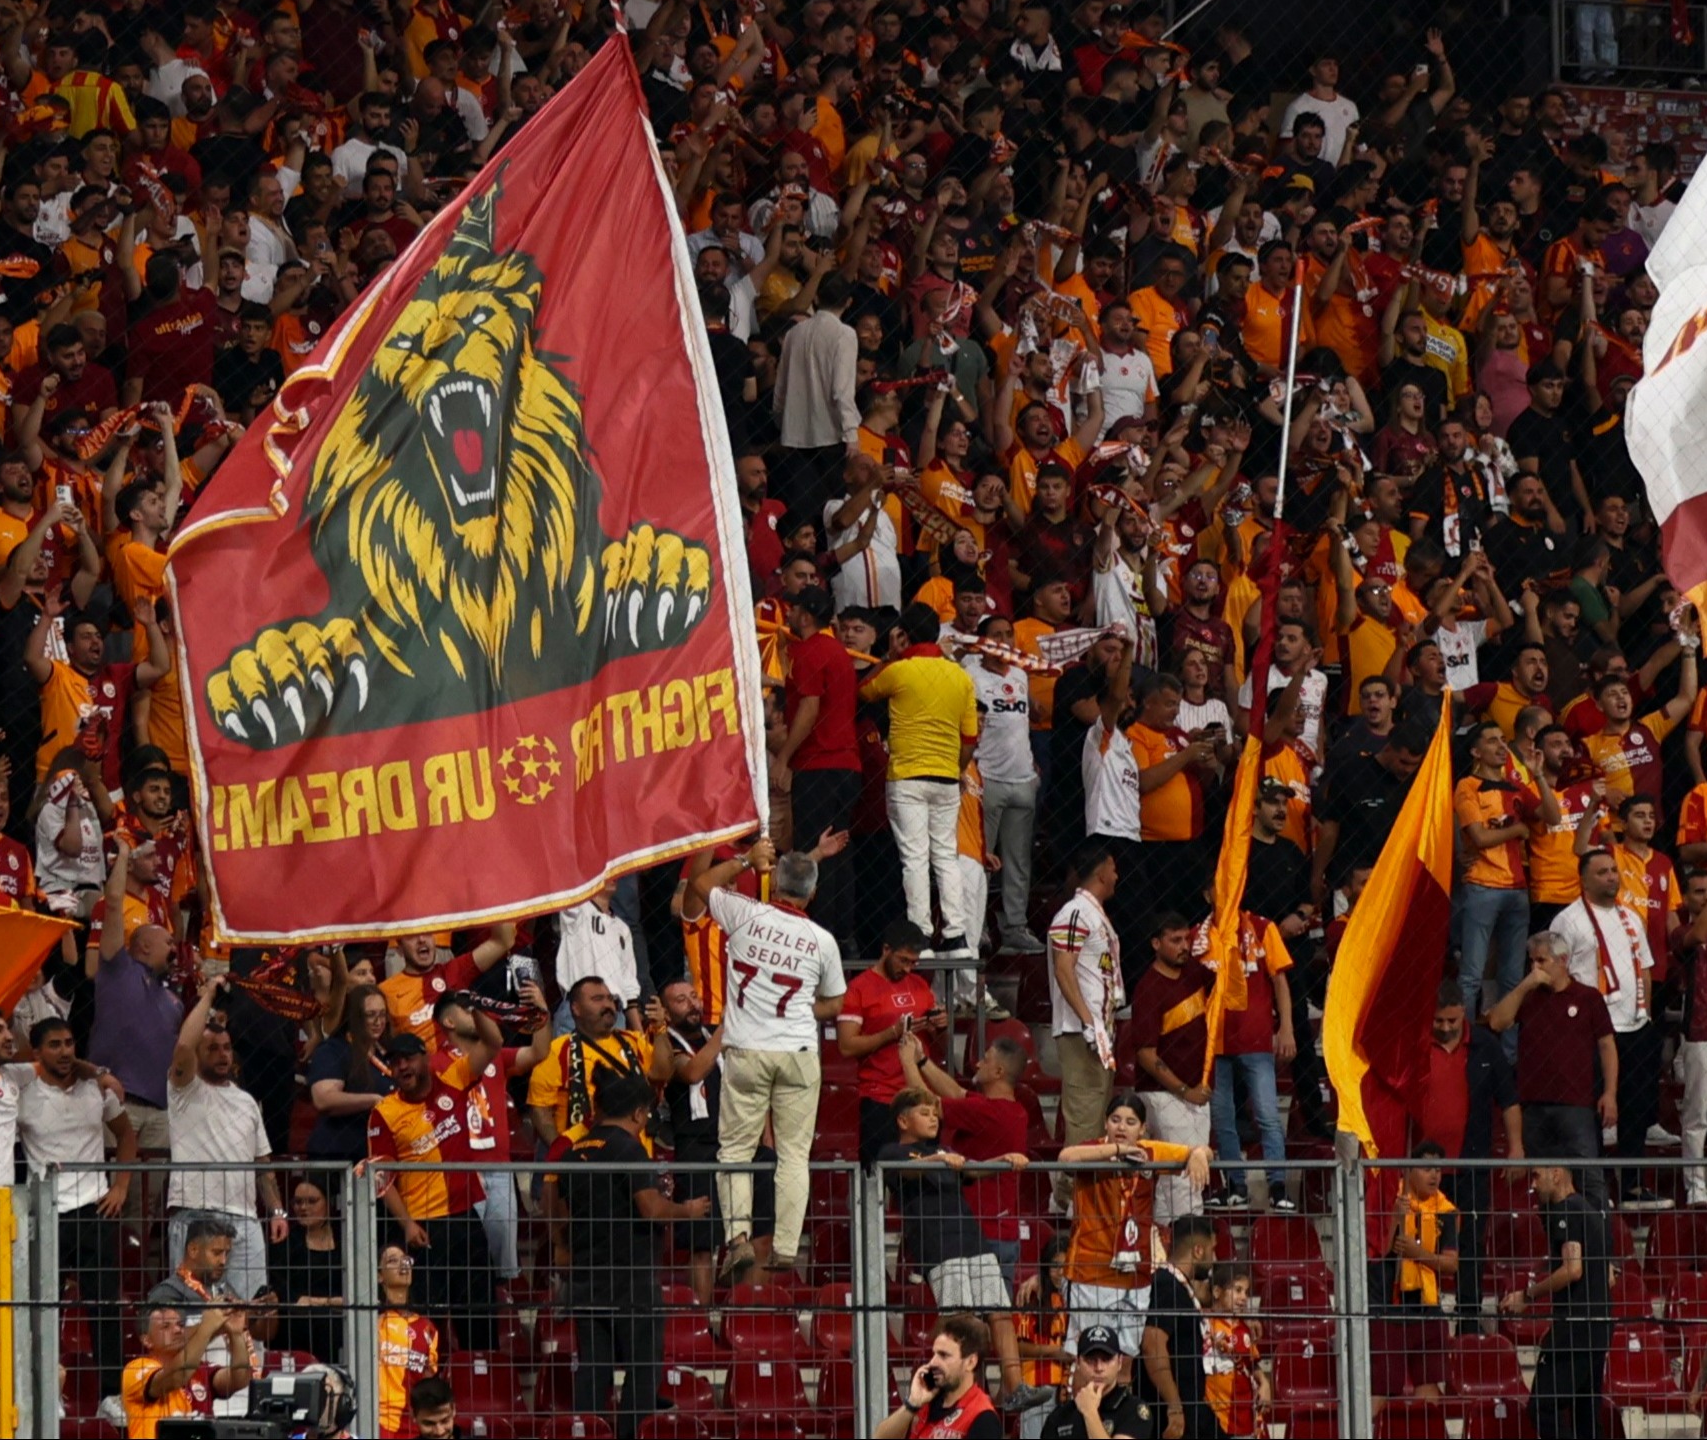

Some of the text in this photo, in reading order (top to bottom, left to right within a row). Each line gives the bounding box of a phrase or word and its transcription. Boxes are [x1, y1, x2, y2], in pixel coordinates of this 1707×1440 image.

[992, 700, 1028, 713] SIXT
[747, 919, 818, 957] İKİZLER
[746, 944, 803, 972] SEDAT
[731, 958, 804, 1019] 77
